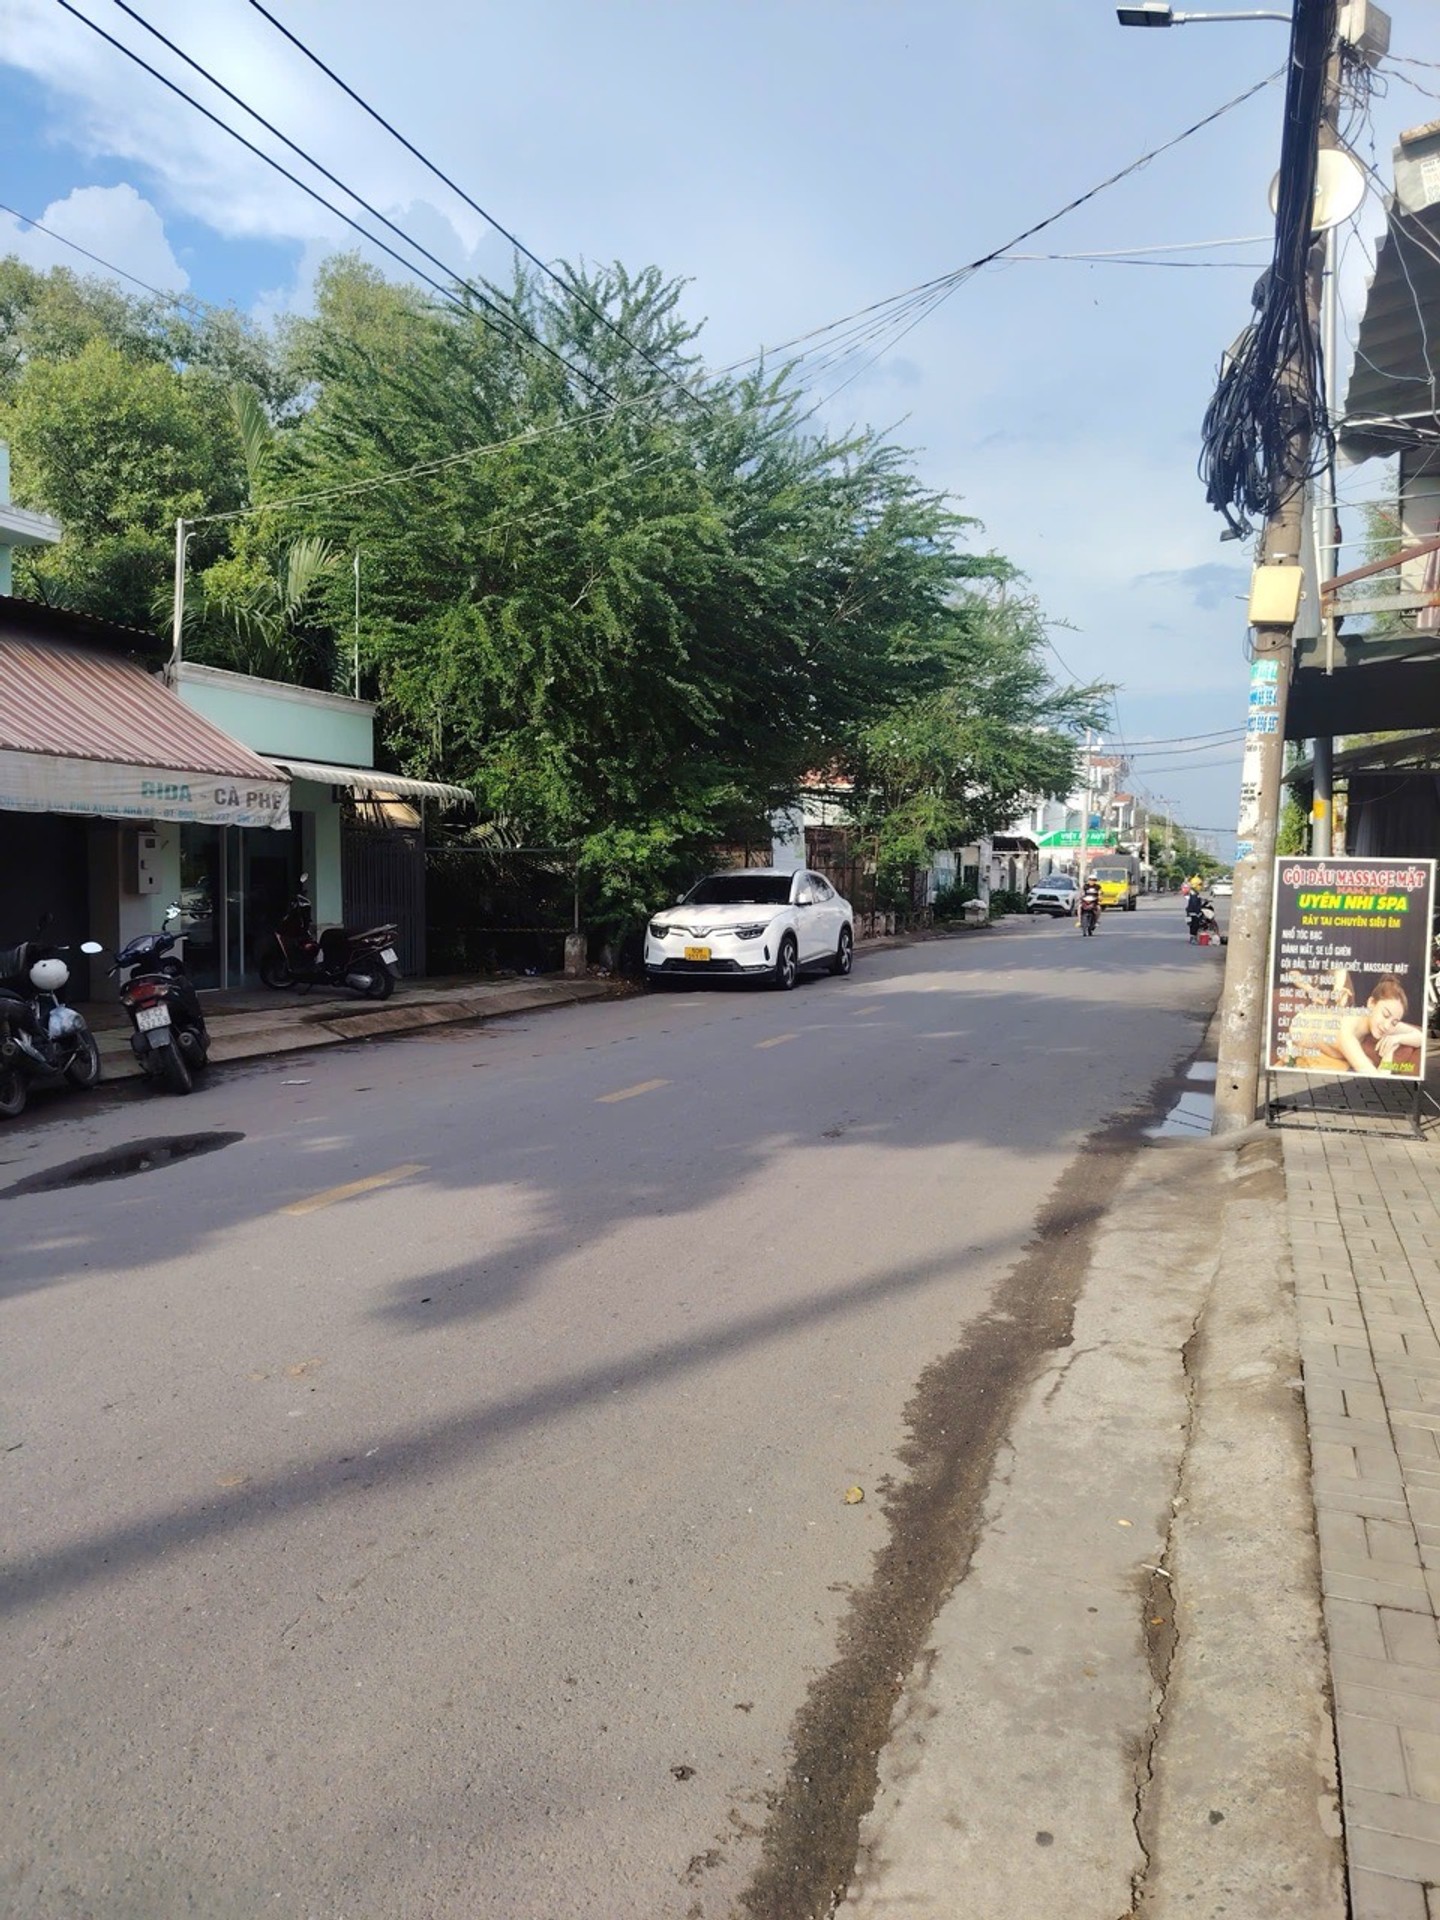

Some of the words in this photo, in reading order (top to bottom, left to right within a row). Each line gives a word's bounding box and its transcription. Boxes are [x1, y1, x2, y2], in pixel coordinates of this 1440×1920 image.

[214, 786, 240, 807] CÀ
[246, 789, 283, 811] PHÊ
[1282, 864, 1305, 889] GỘI
[1306, 862, 1334, 886] ĐẦU
[1335, 869, 1395, 888] MASSAGE
[1395, 866, 1426, 892] MẶT
[1298, 891, 1341, 909] UYÊN
[1343, 895, 1374, 910] NHI
[1376, 896, 1408, 911] SPA
[1320, 916, 1333, 926] TAI
[1363, 962, 1394, 974] MASSAGE
